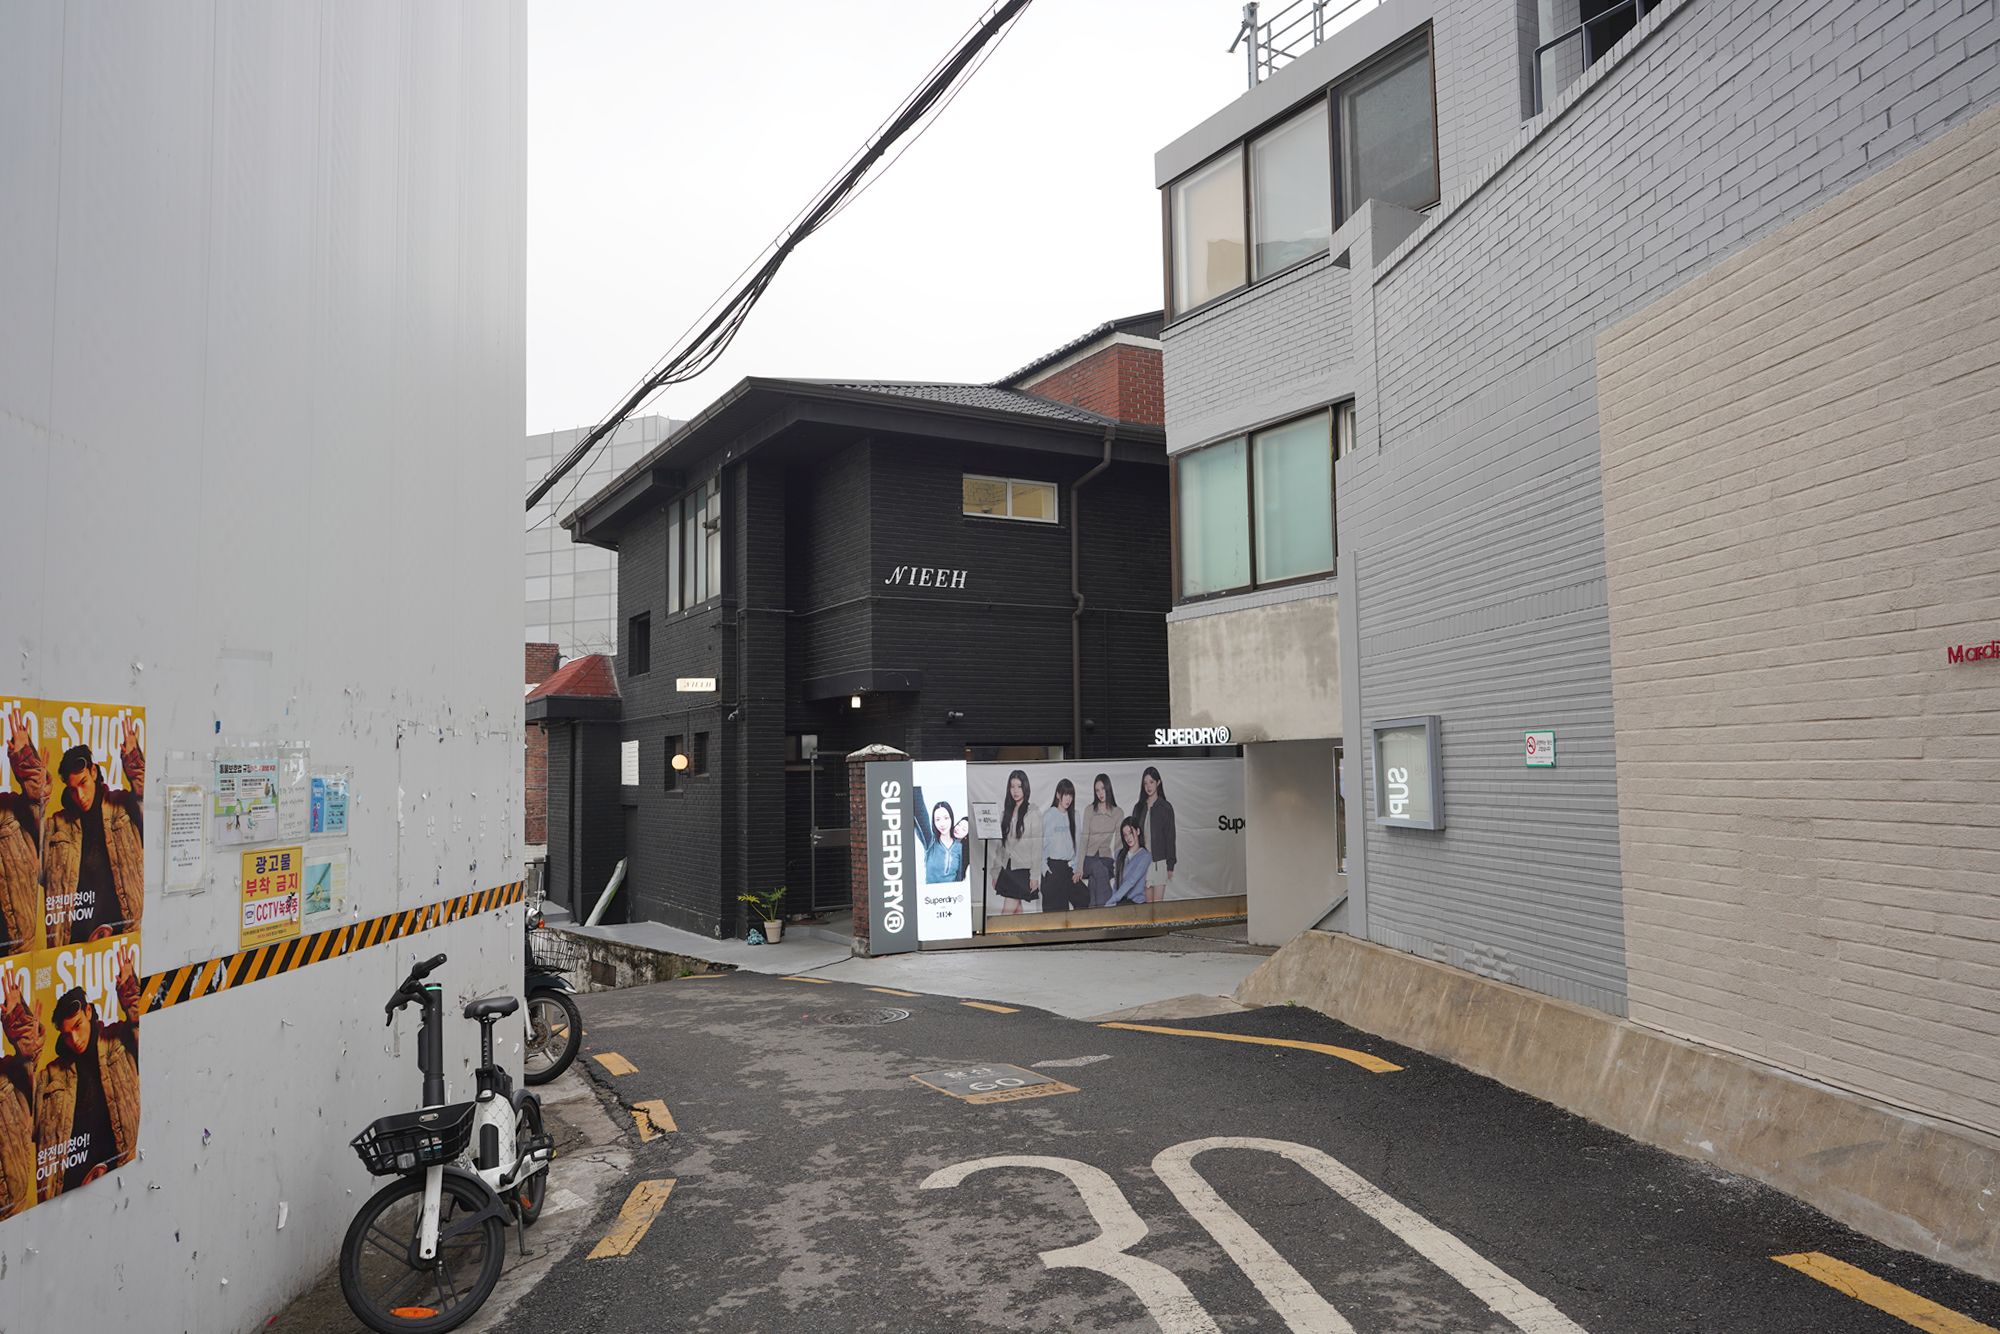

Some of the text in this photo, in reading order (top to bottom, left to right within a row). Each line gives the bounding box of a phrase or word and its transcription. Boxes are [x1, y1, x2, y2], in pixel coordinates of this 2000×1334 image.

[885, 565, 968, 589] NIEEH
[1218, 815, 1246, 834] Sup
[256, 853, 290, 874] 광고물
[246, 872, 298, 897] 부착 금지
[45, 907, 95, 926] OUT NOW
[36, 1161, 60, 1181] OUT
[61, 1149, 89, 1171] NOW
